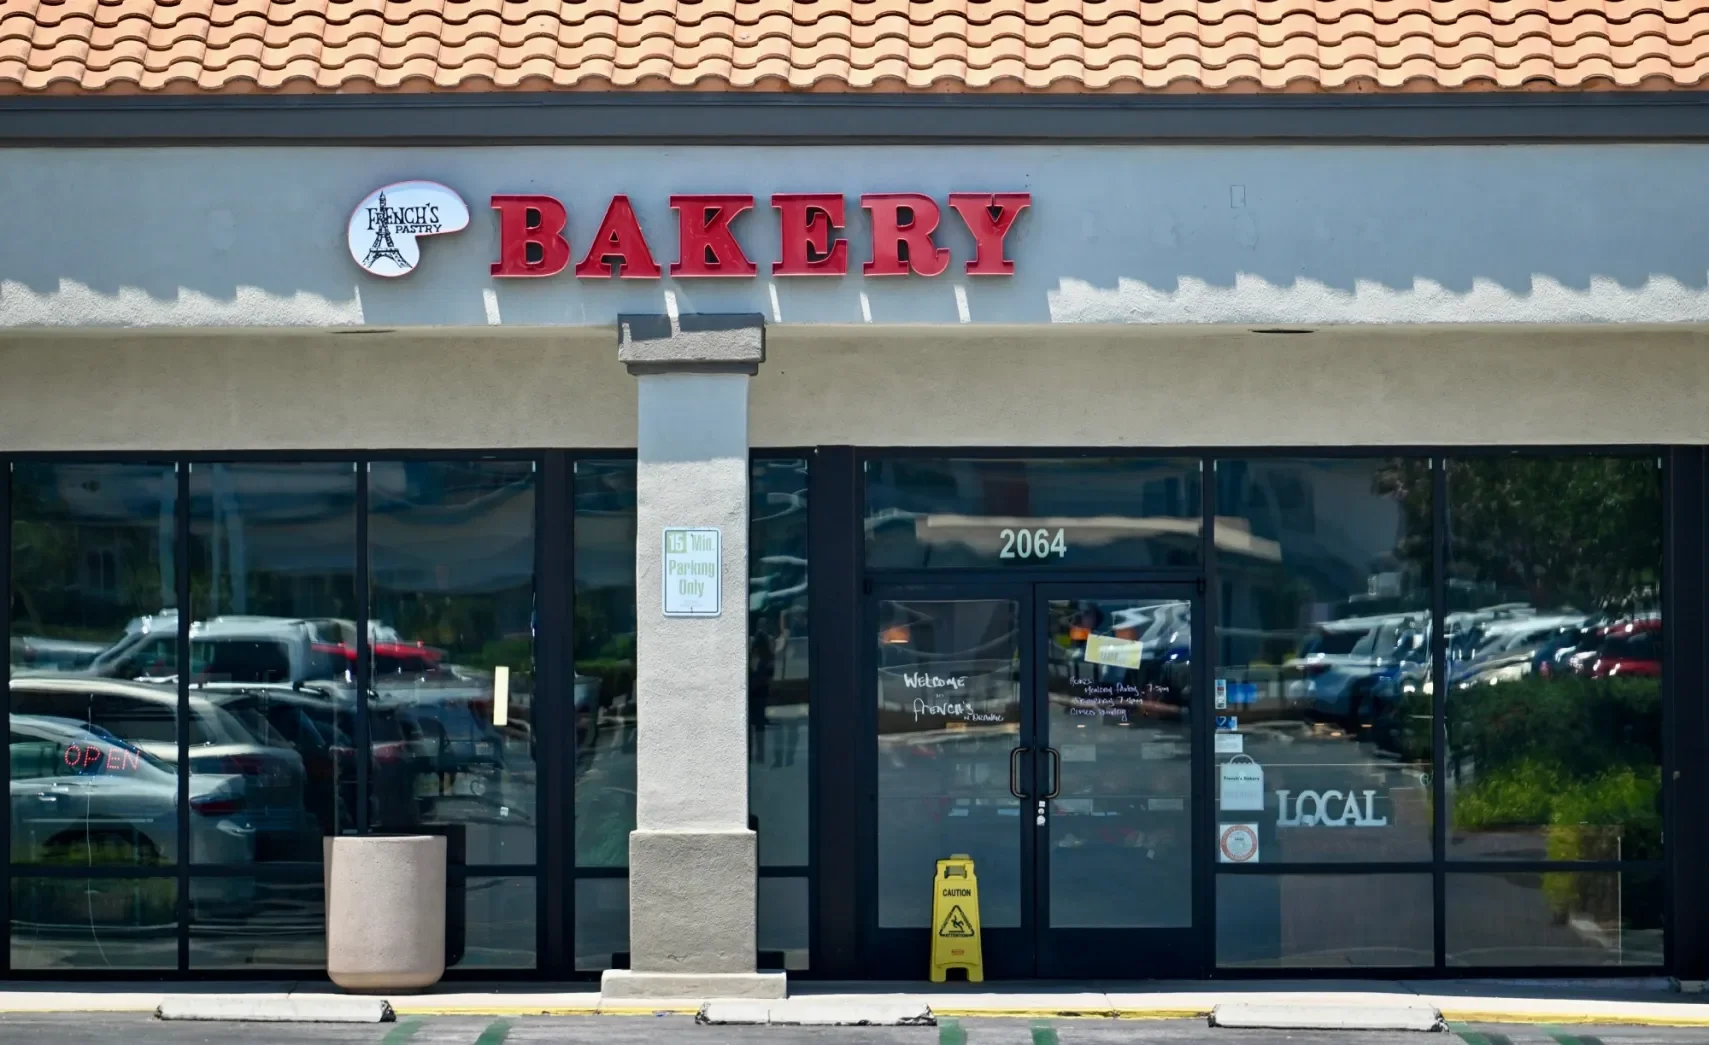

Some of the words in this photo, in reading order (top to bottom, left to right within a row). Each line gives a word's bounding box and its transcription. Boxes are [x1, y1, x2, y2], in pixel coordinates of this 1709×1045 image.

[365, 202, 440, 230] FRENCH'S
[395, 224, 442, 234] PASTRY
[489, 193, 1031, 279] BAKERY
[668, 533, 684, 552] 15
[691, 533, 716, 552] Min.
[999, 527, 1067, 558] 2064
[668, 559, 716, 579] Parking
[678, 579, 705, 598] Only
[64, 744, 141, 770] OPEN
[1275, 789, 1388, 827] LOCAL
[942, 888, 972, 897] CAUTION
